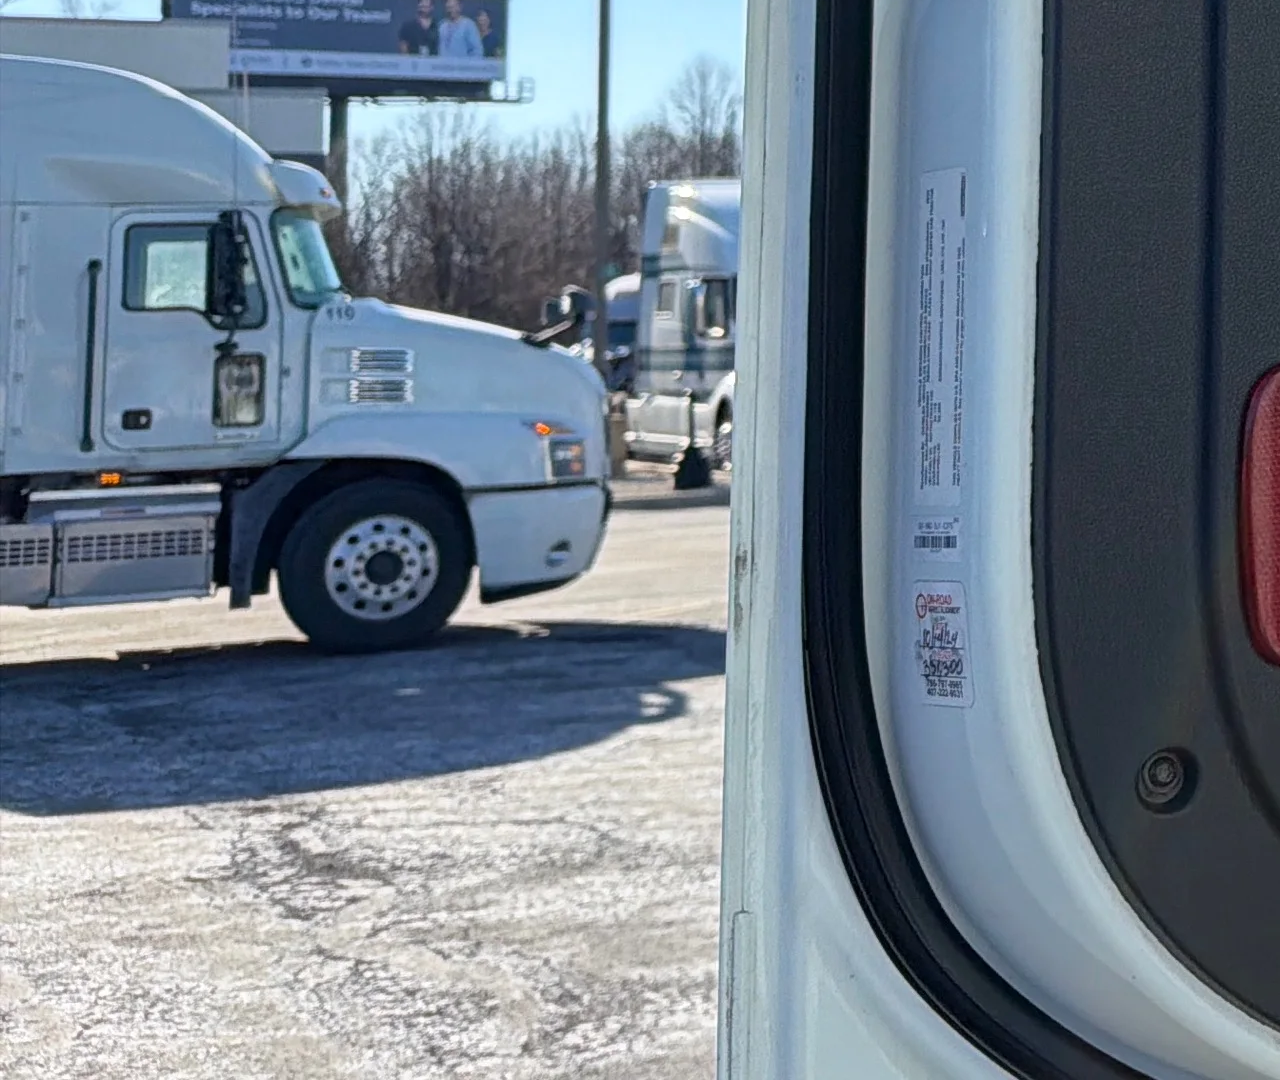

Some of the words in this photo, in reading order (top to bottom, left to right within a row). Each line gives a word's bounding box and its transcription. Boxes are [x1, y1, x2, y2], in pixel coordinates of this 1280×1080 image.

[190, 0, 283, 18] Specialists
[285, 5, 305, 19] to
[308, 6, 340, 20] Our
